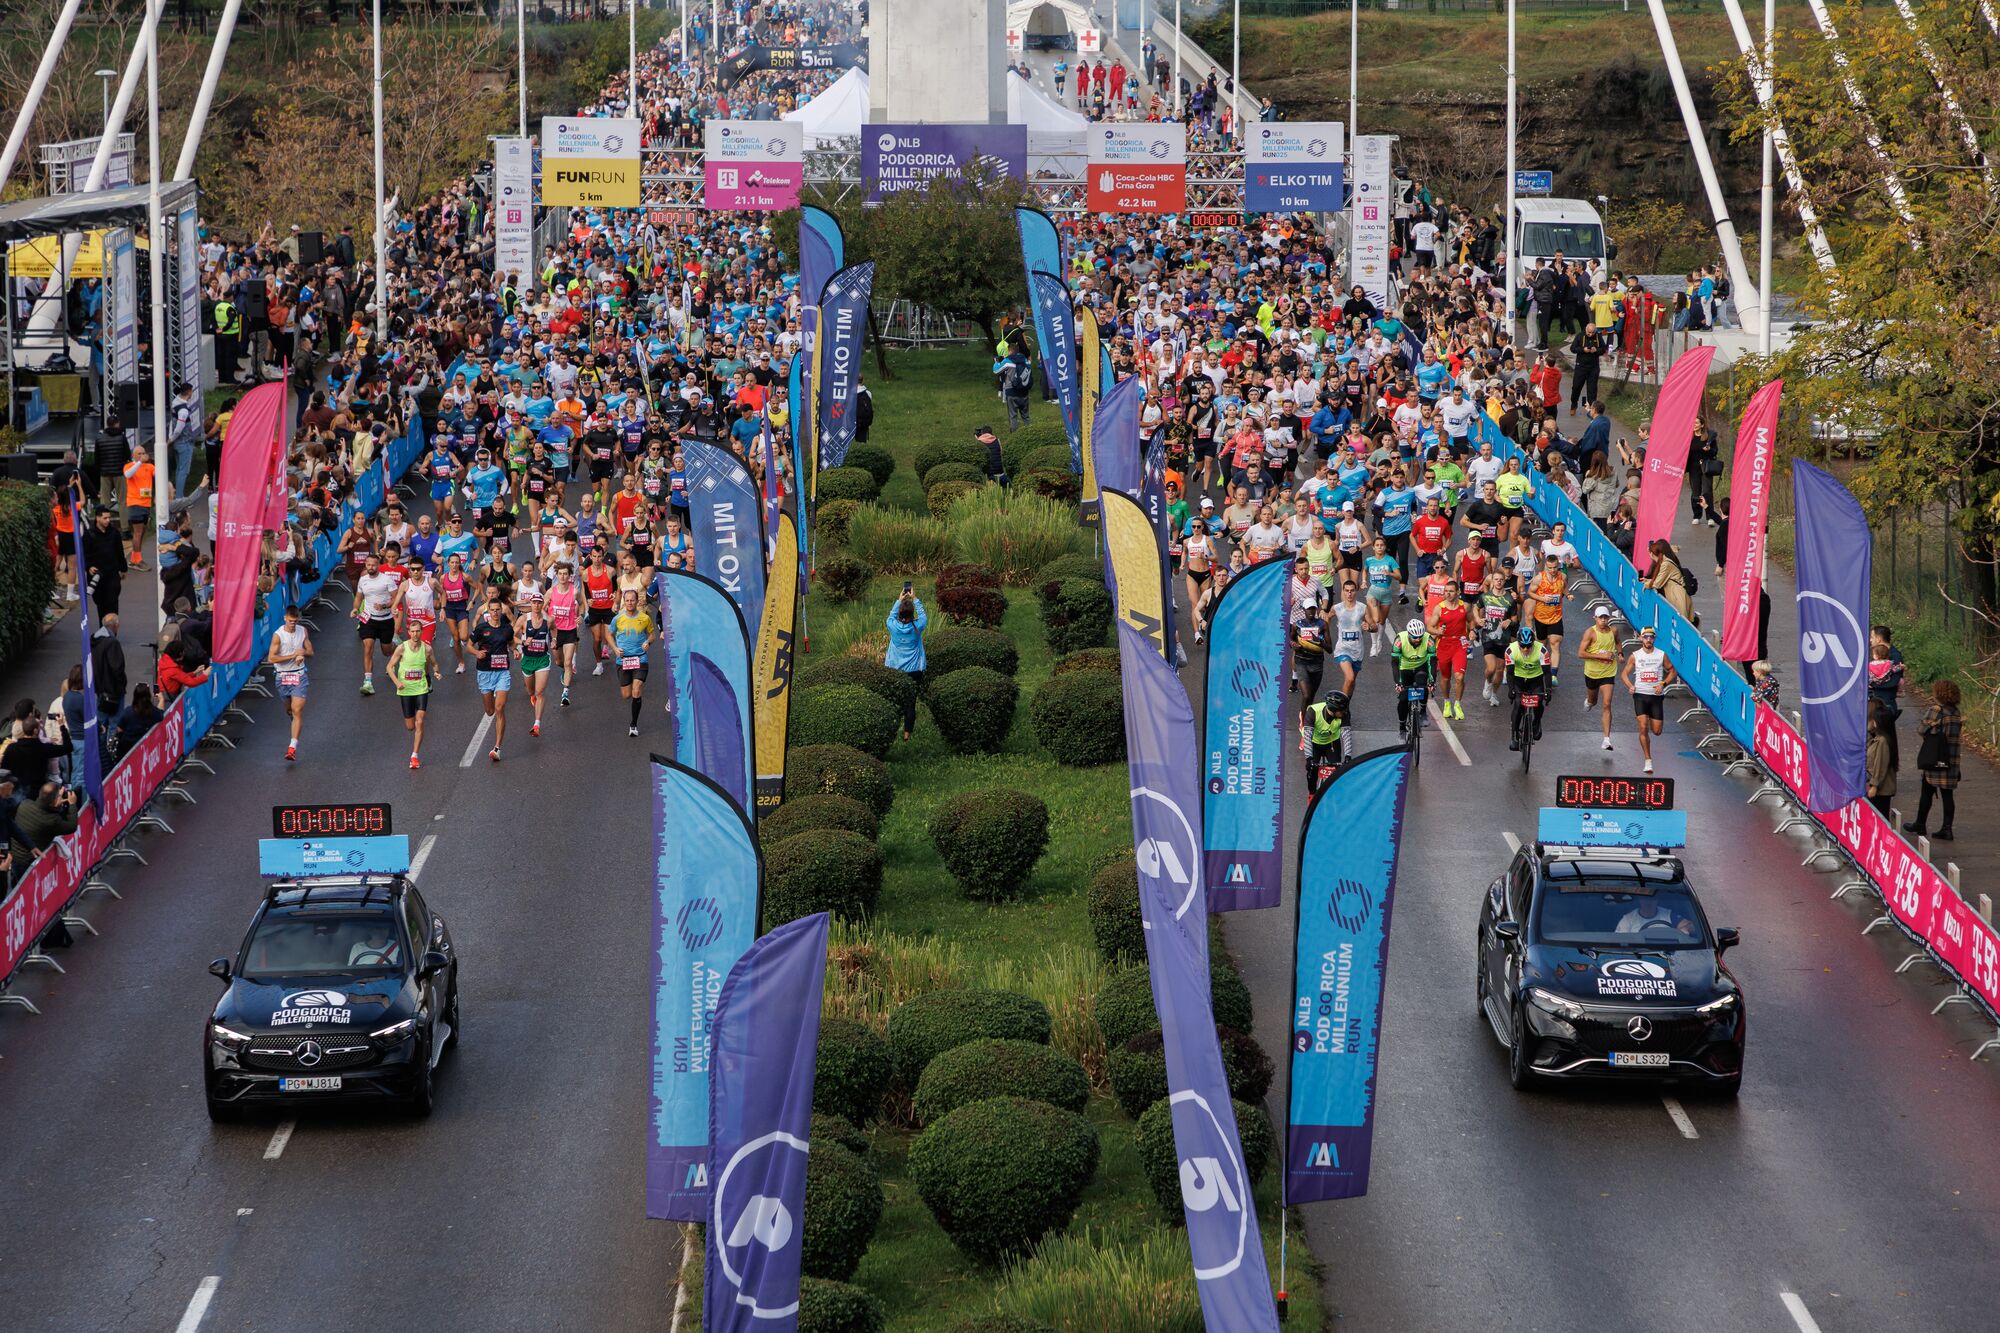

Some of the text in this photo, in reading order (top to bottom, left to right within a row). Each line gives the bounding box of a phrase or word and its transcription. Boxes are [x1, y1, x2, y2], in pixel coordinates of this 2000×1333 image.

[770, 50, 795, 59] FUN
[801, 50, 833, 67] 5km
[770, 58, 795, 67] RUN
[898, 138, 921, 148] NLB
[879, 154, 956, 166] PODGORICA
[556, 171, 625, 184] FUNRUN
[763, 177, 791, 185] Telekom
[1115, 174, 1175, 182] Coca-Cola HBC
[1270, 175, 1332, 186] ELKO TIM
[1115, 182, 1155, 190] Crna Gora
[579, 192, 603, 201] 5 km
[735, 195, 774, 205] 21.1 km
[1117, 198, 1157, 207] 42.2 km
[1280, 197, 1309, 206] 10 km
[1192, 214, 1238, 226] 00:00:10
[833, 308, 853, 400] ELKO TIM
[1226, 714, 1241, 795] PODGORICA
[1240, 708, 1255, 795] MILLENNIUM
[1212, 751, 1222, 774] NLB
[1255, 767, 1266, 795] RUN
[1564, 780, 1665, 805] 00:00:10
[282, 807, 383, 833] 00:00:08
[1901, 862, 1922, 918] 5G
[14, 894, 25, 951] 5G
[1984, 936, 1998, 999] 5G
[1597, 978, 1676, 990] PODGORICA
[1598, 987, 1677, 997] MILLENNIUM RUN
[1315, 950, 1337, 1053] PODGORICA
[1331, 943, 1353, 1054] MILLENNIUM
[272, 1007, 351, 1020] PODGORICA
[1298, 996, 1312, 1027] NLB
[271, 1015, 350, 1027] MILLENNIUM RUN
[1347, 1018, 1362, 1054] RUN
[1616, 1054, 1668, 1065] PG LS322
[287, 1078, 301, 1089] PG
